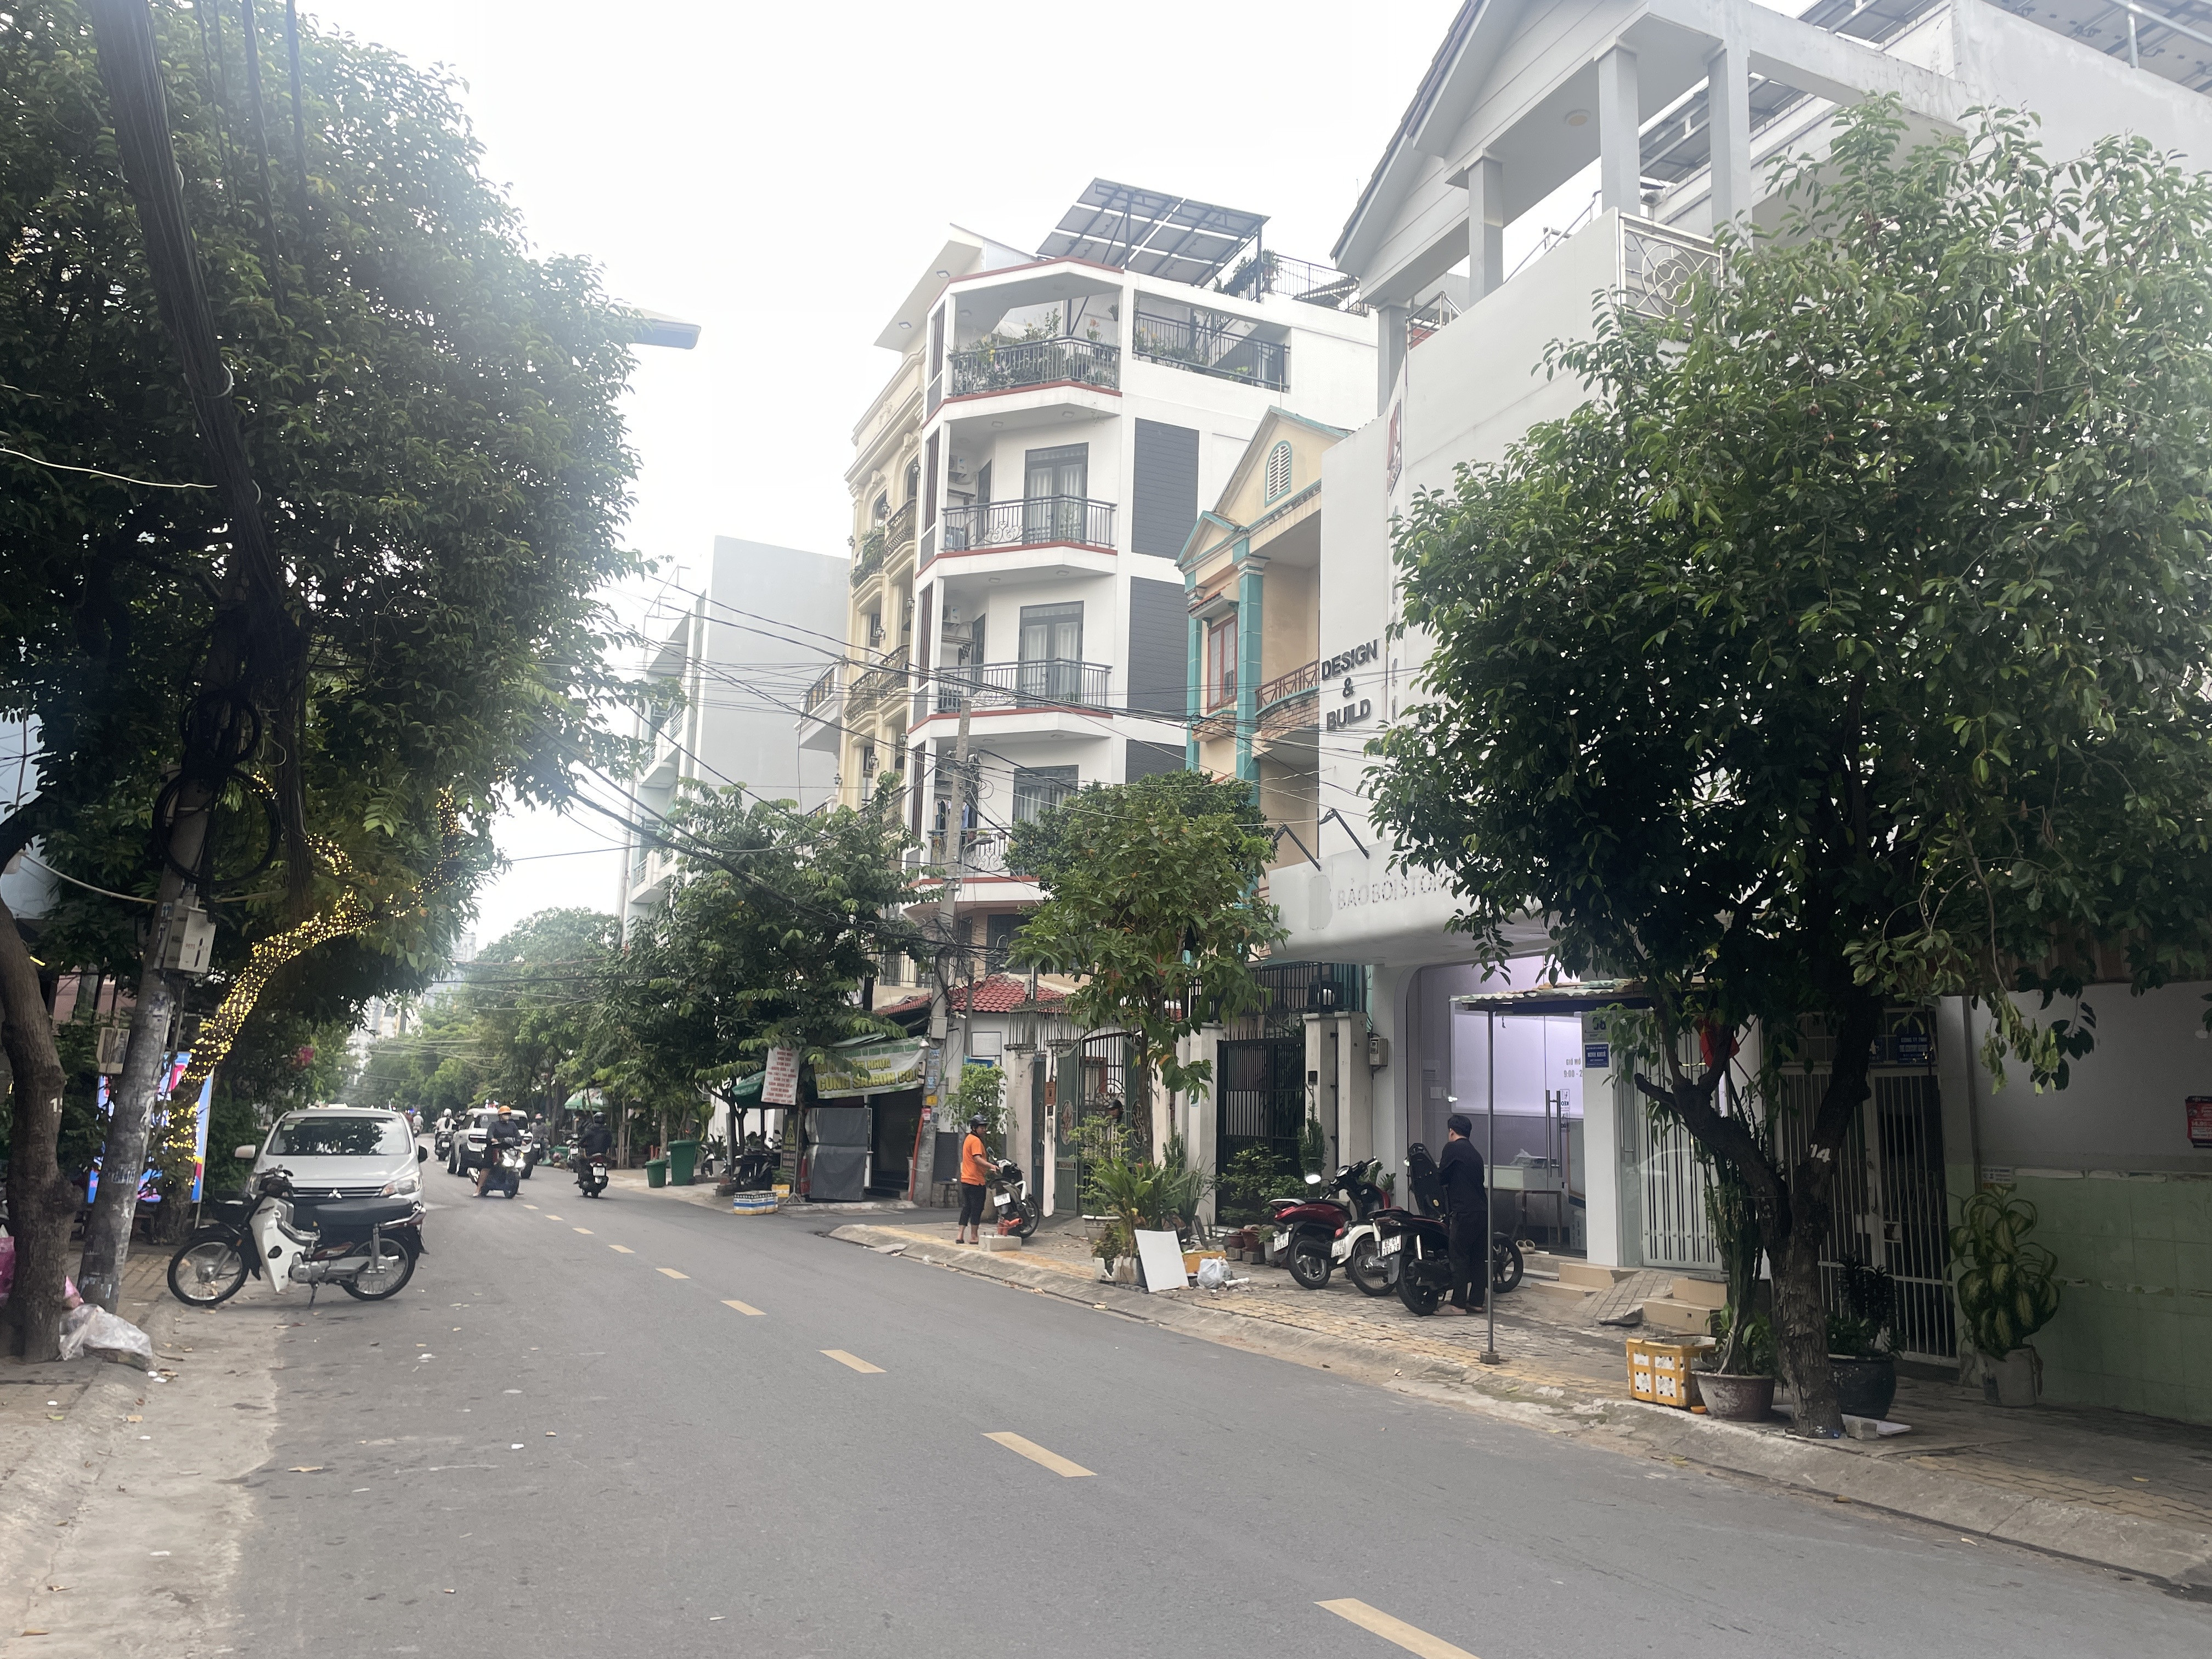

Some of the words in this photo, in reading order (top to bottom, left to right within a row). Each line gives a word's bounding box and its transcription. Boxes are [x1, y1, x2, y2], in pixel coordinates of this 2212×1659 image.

[1322, 639, 1378, 680] DESIGN
[1342, 677, 1355, 698] &
[1327, 698, 1372, 731] BUILD
[867, 1057, 891, 1071] NHỰA
[817, 1074, 850, 1092] CÙNG
[1564, 1070, 1575, 1078] 9:00
[1810, 1144, 1831, 1163] 14
